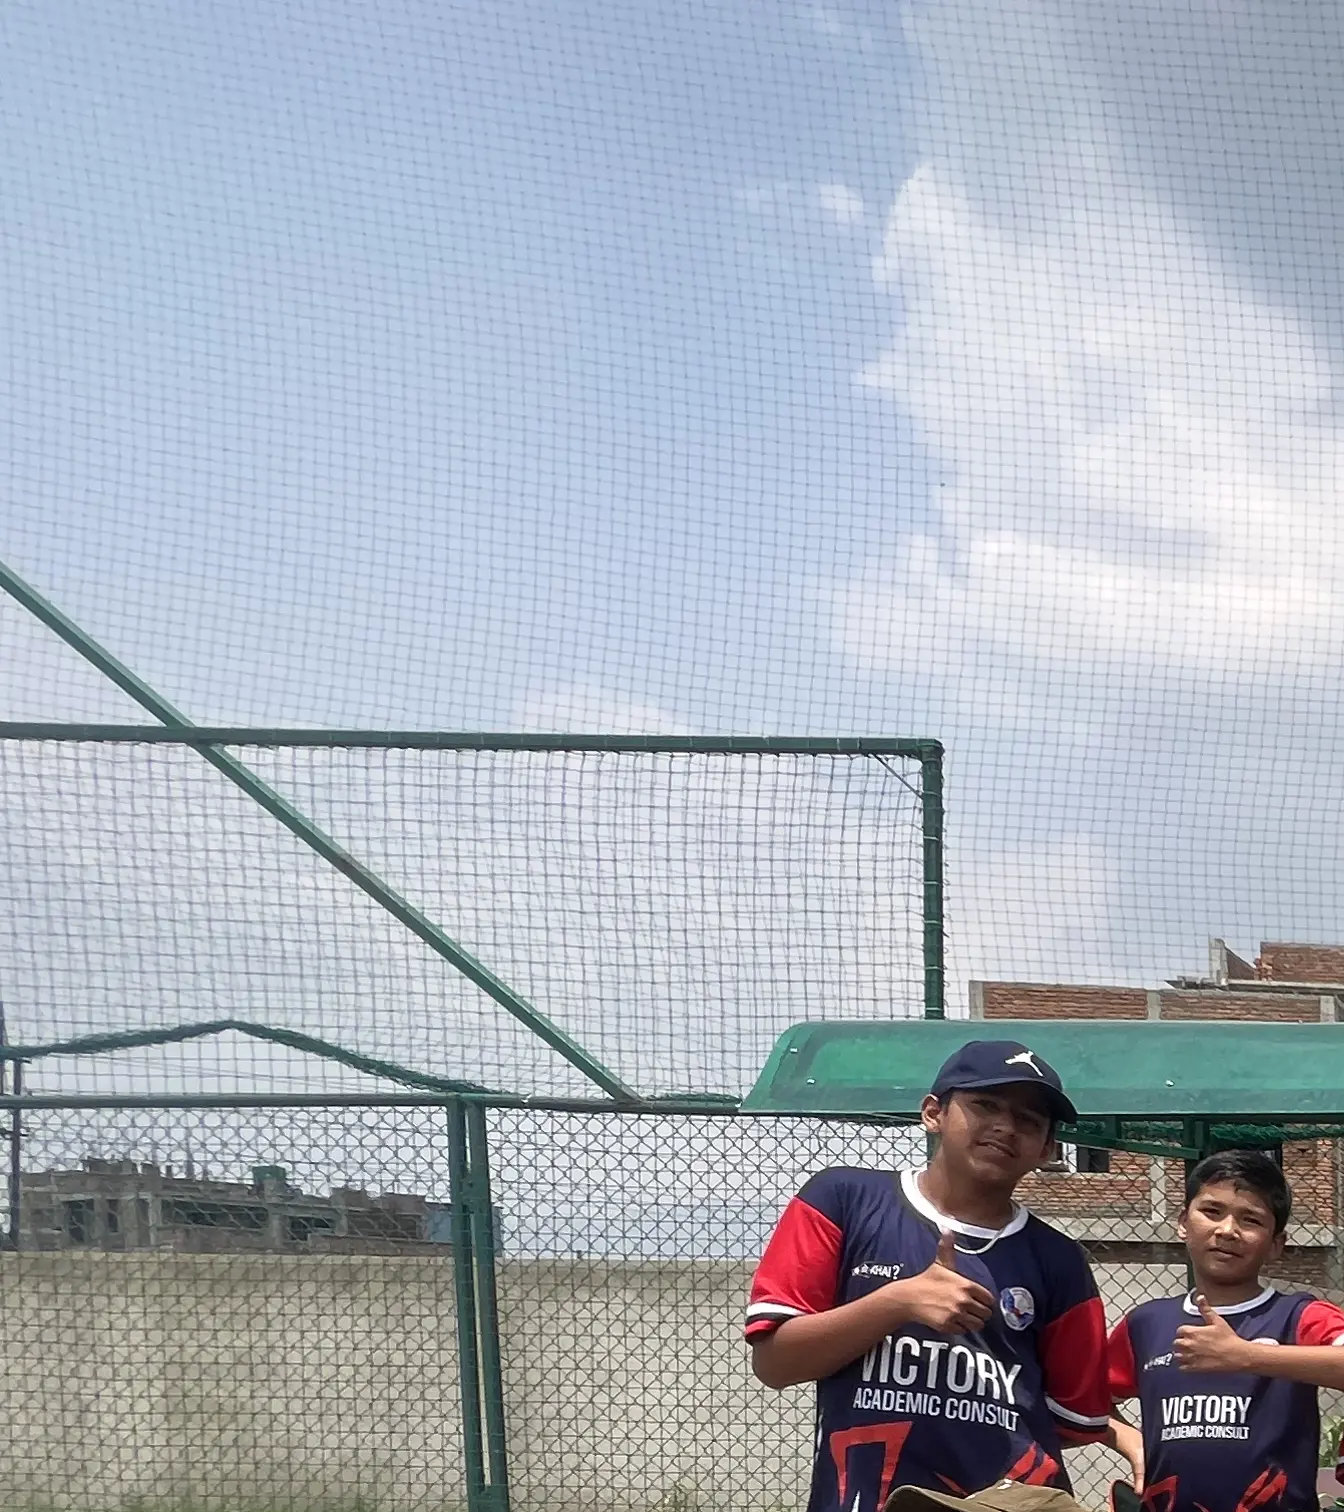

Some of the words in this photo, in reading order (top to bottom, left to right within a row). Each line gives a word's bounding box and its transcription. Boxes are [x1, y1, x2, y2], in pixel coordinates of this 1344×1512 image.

[862, 1335, 1022, 1405] VICTORY
[853, 1387, 941, 1416] ACADEMIC
[945, 1397, 1020, 1432] CONSULT
[1162, 1395, 1252, 1425] VICTORY
[1205, 1425, 1250, 1440] CONSULT
